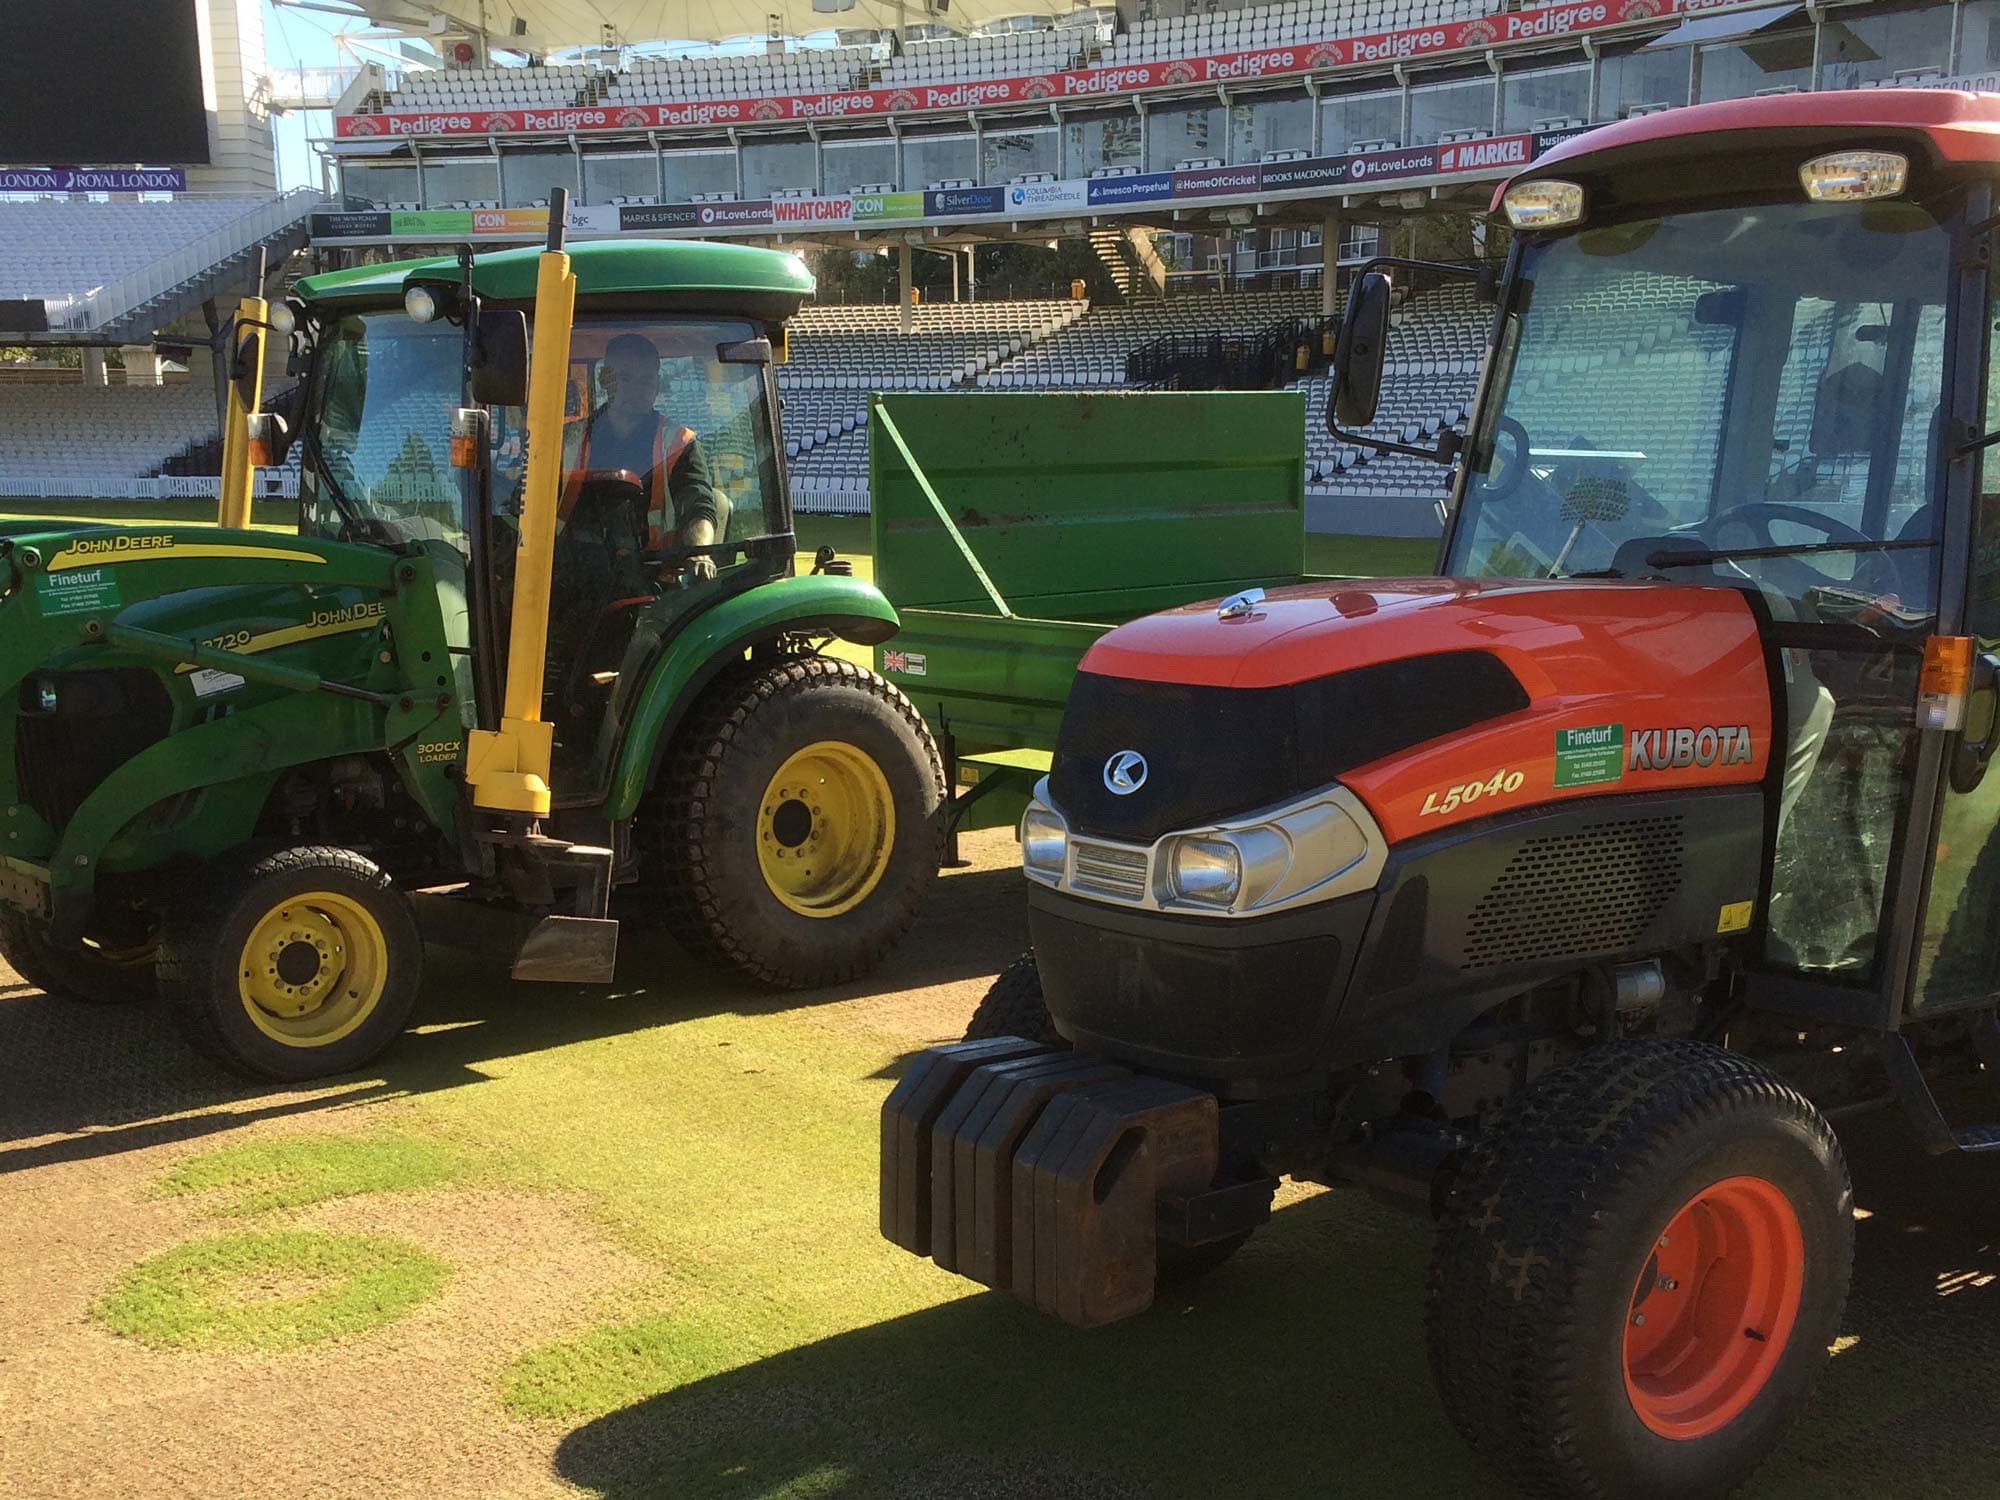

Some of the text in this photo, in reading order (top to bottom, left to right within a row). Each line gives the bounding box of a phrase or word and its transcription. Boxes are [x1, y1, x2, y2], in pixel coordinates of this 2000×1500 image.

[1507, 4, 1607, 39] Pedigree
[1352, 29, 1446, 59] Pedigree
[1205, 52, 1295, 79] Pedigree
[1063, 69, 1150, 94] Pedigree
[927, 84, 1010, 106] Pedigree
[657, 104, 740, 124] Pedigree
[792, 94, 875, 117] Pedigree
[389, 116, 472, 135] Pedigree
[523, 109, 606, 131] Pedigree
[1459, 140, 1525, 167] MARKEL
[1367, 155, 1433, 174] #LoveLords
[77, 174, 180, 188] ROYAL LONDON
[1262, 169, 1342, 184] BROOKS MACDONALD
[1103, 182, 1170, 196] Invesco Perpetual
[853, 199, 884, 213] ICON
[946, 195, 993, 206] SilverDoor
[474, 214, 505, 227] ICON
[572, 215, 589, 226] bgc
[622, 215, 651, 223] MARKS
[658, 212, 697, 222] SPENCER
[716, 209, 773, 221] #LoveLords
[66, 535, 174, 554] JOHN DEERE
[49, 570, 103, 587] Fineturf
[307, 602, 386, 627] JOHN DEE
[1567, 725, 1612, 746] Fineturf
[417, 741, 460, 754] 300CX
[1629, 726, 1752, 771] KUBOTA
[420, 753, 457, 763] LOADER
[1419, 769, 1525, 817] L5040
